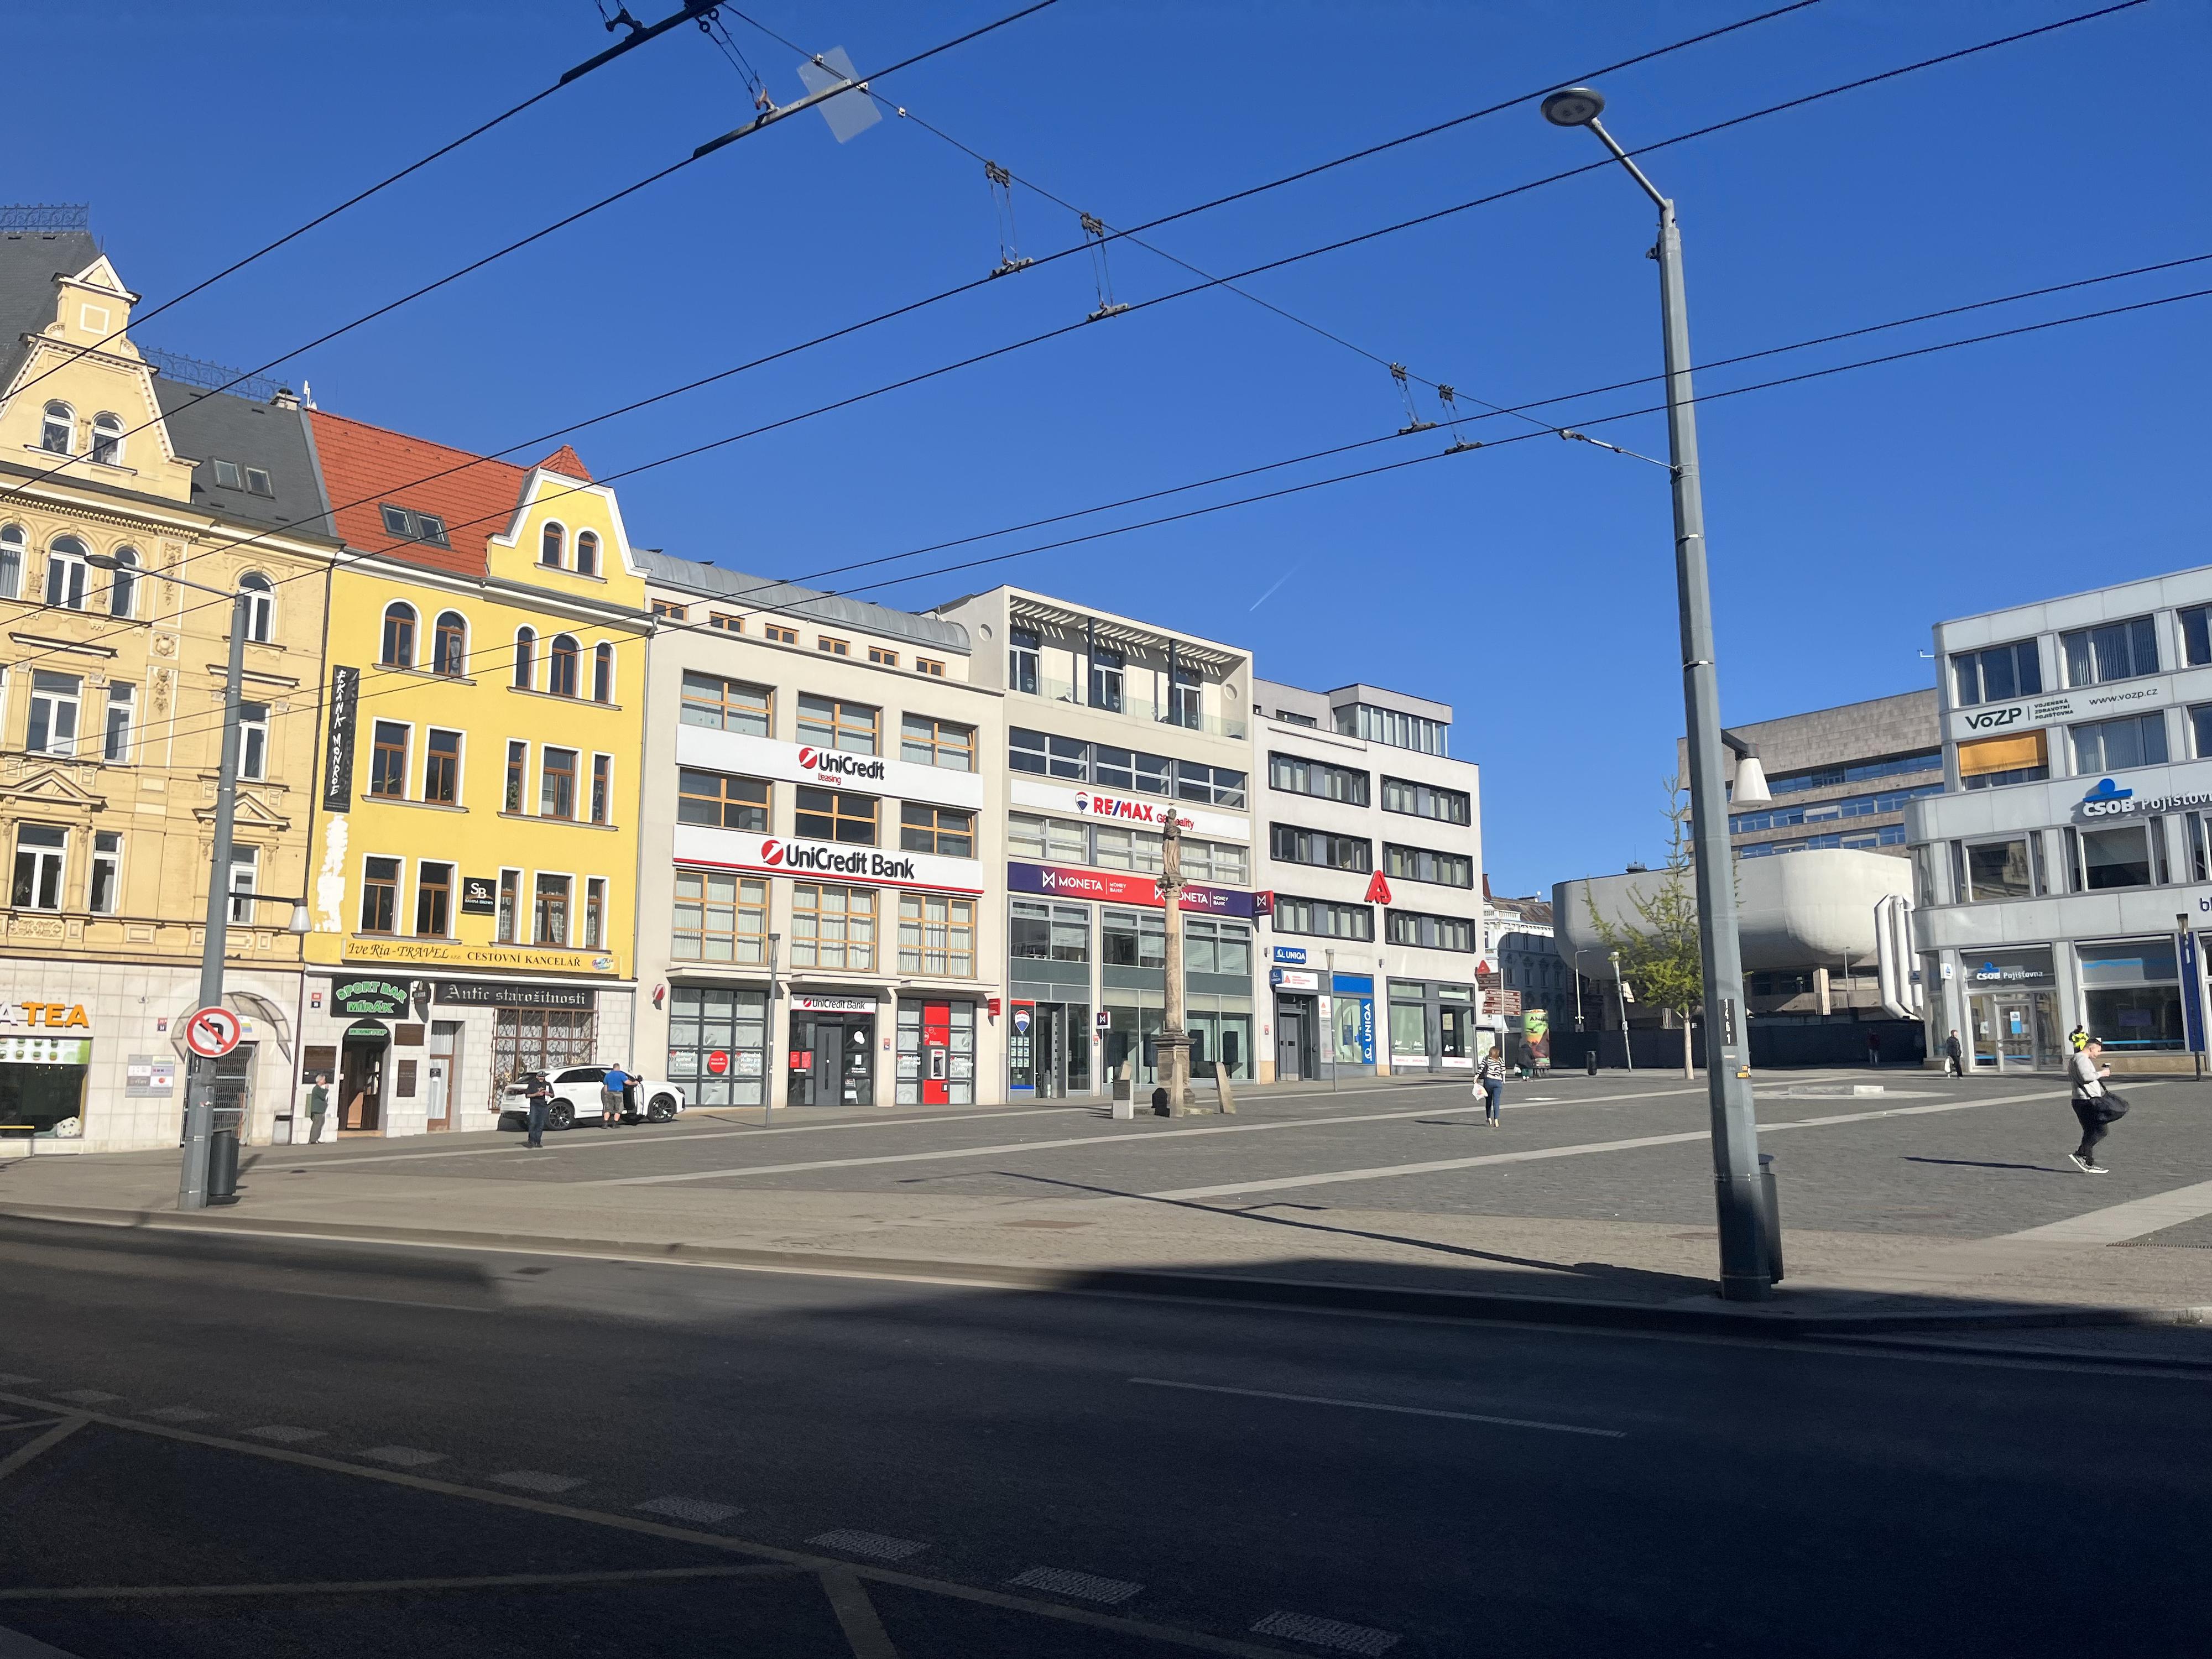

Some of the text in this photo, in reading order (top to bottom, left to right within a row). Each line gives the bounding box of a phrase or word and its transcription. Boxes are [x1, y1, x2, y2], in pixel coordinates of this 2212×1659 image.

[333, 670, 346, 729] FRANK
[2089, 688, 2158, 705] www.vozp.cz
[330, 733, 342, 796] MONROE
[818, 752, 885, 781] UniCredit
[818, 773, 841, 785] Leasing
[1094, 796, 1153, 822] RE/MAX
[785, 843, 915, 880] UniCredit Bank
[471, 883, 487, 899] SB
[1058, 876, 1103, 891] MONETA
[348, 943, 368, 954] Ive
[1286, 951, 1306, 960] UNIQA
[467, 952, 580, 967] CESTOVNÍ KANCELÁŘ
[336, 981, 408, 1004] SPORT BAR
[444, 984, 585, 1004] Antic starožitnosti
[347, 1000, 395, 1013] MÍRÁK
[812, 998, 865, 1009] UniCredit Bank
[21, 1001, 89, 1028] TEA
